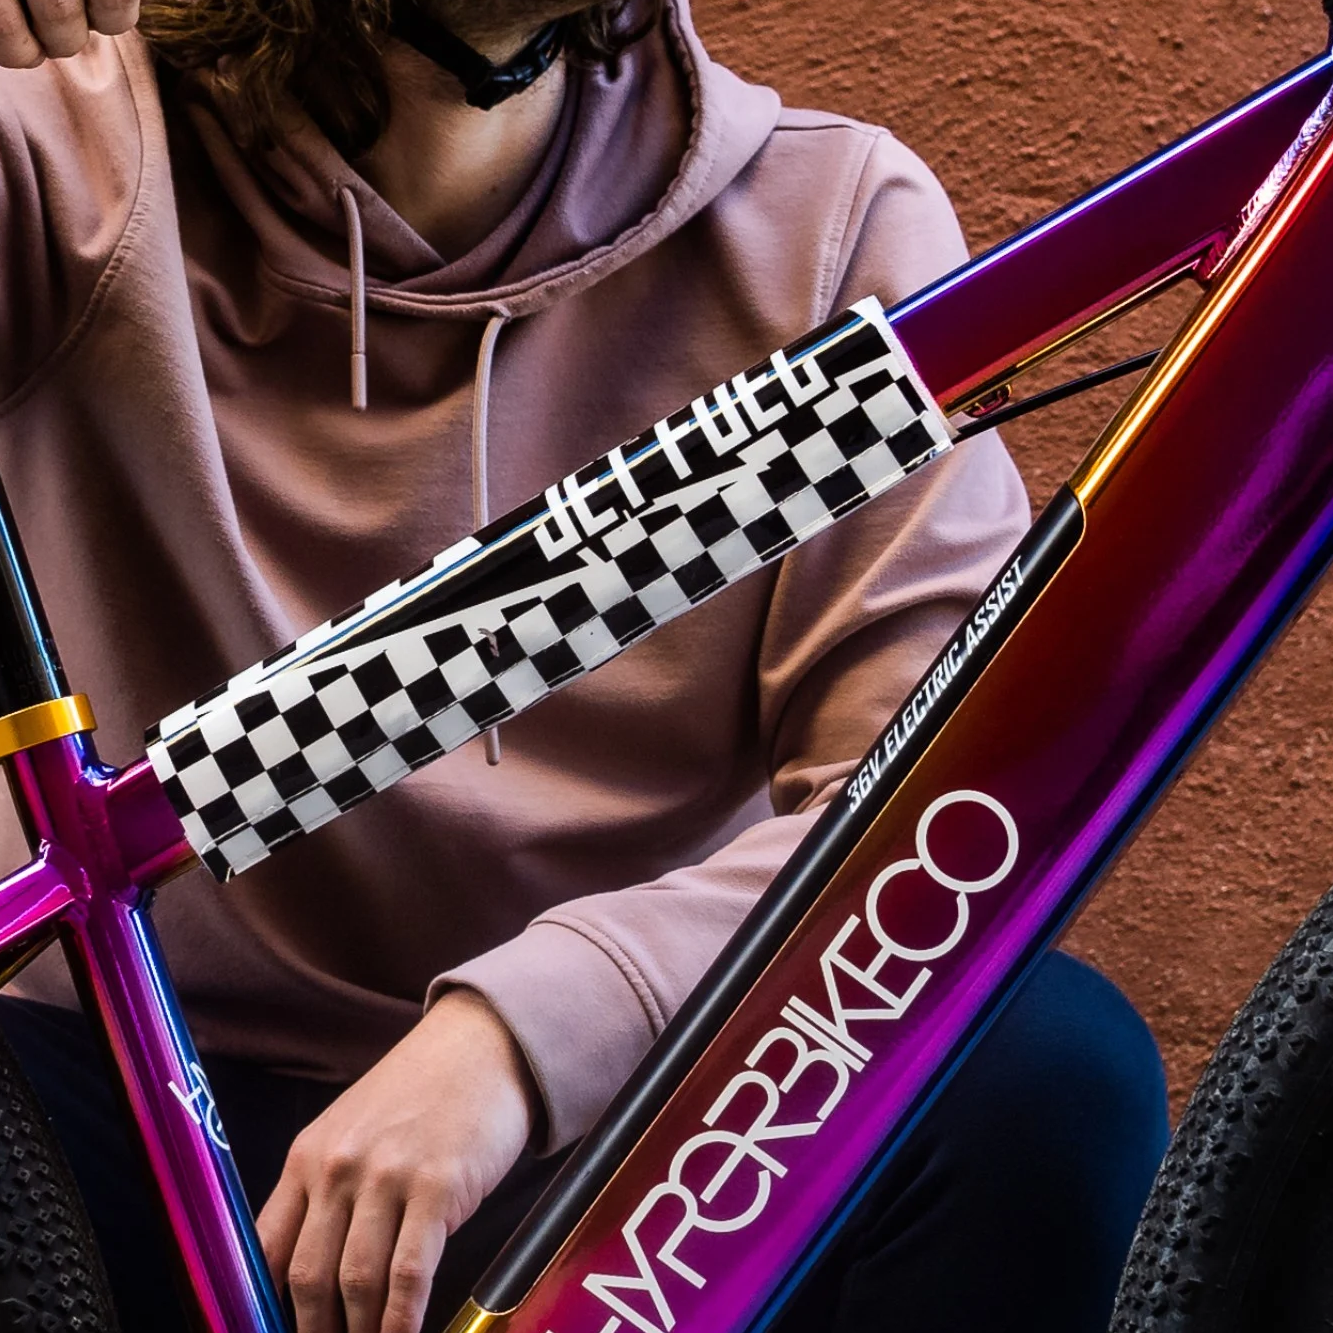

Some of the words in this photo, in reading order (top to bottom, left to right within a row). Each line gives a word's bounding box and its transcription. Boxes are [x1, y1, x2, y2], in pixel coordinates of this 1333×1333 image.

[533, 446, 645, 562] JET
[654, 349, 831, 479] FUEL
[847, 749, 881, 813] 36V
[884, 641, 963, 764] ELECTRIC
[964, 555, 1025, 656] ASSIST
